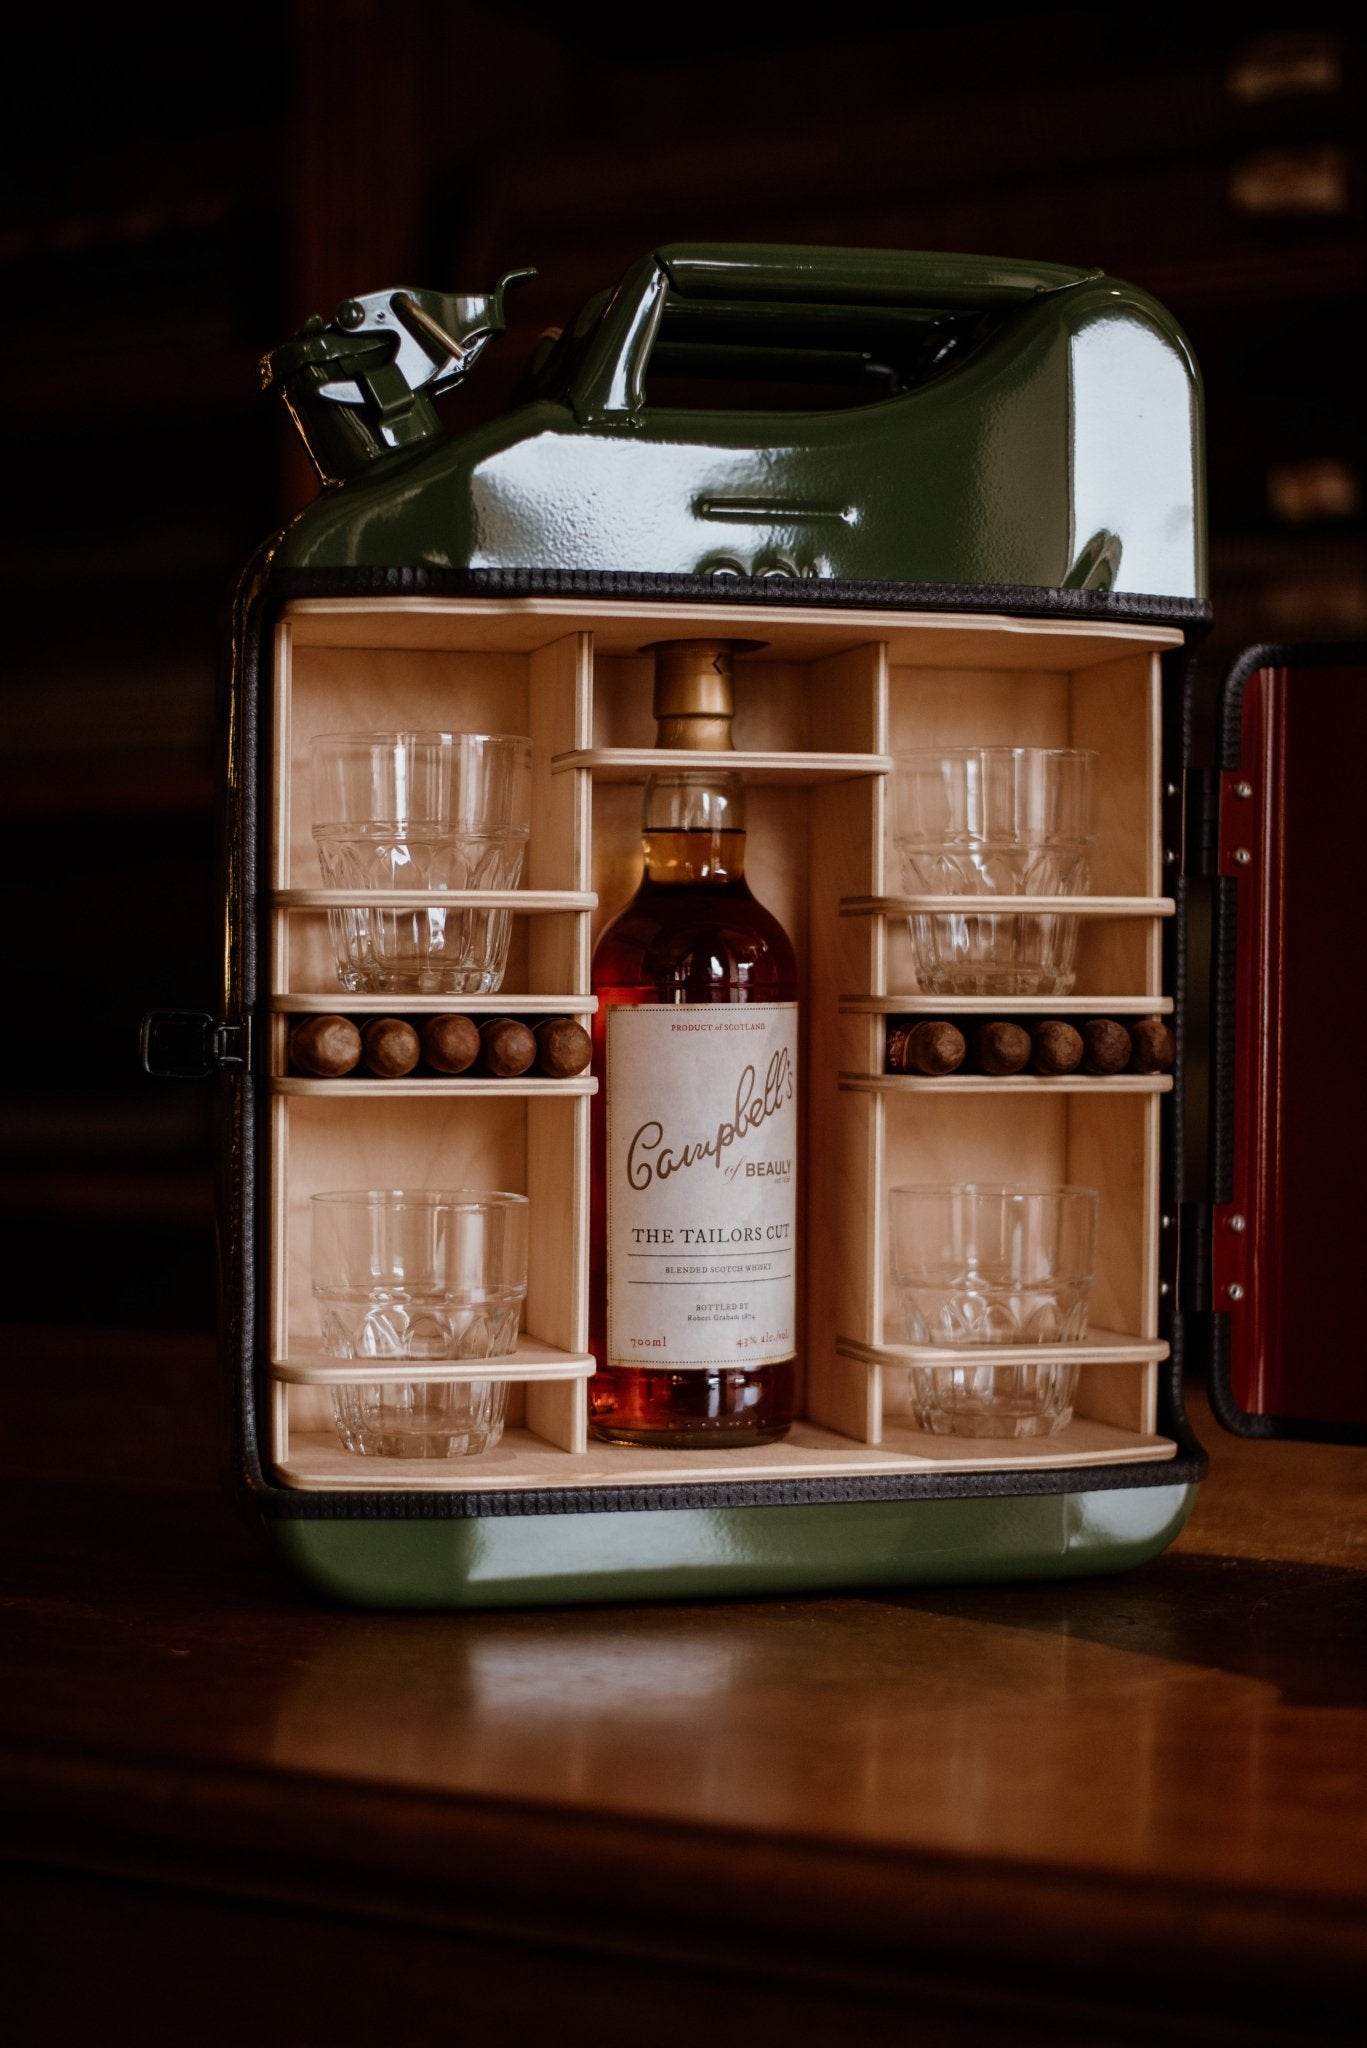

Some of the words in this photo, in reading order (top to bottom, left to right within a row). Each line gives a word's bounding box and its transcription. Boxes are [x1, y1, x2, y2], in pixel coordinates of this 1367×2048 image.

[671, 1024, 713, 1032] PRODUCT
[715, 1023, 724, 1031] of
[724, 1023, 766, 1031] SCOTLAND
[627, 1046, 793, 1191] Campbell's
[723, 1157, 744, 1184] of
[745, 1160, 791, 1177] BEAULY
[632, 1228, 674, 1243] THE
[680, 1227, 762, 1243] TAILORS
[766, 1223, 790, 1239] CUT
[665, 1266, 708, 1274] BLENDED
[710, 1265, 743, 1273] SCOTCH
[745, 1263, 772, 1272] WHISKY
[696, 1303, 737, 1311] BOTTLED
[739, 1302, 749, 1310] BY
[713, 1313, 740, 1321] Graham
[630, 1336, 667, 1348] 700ml
